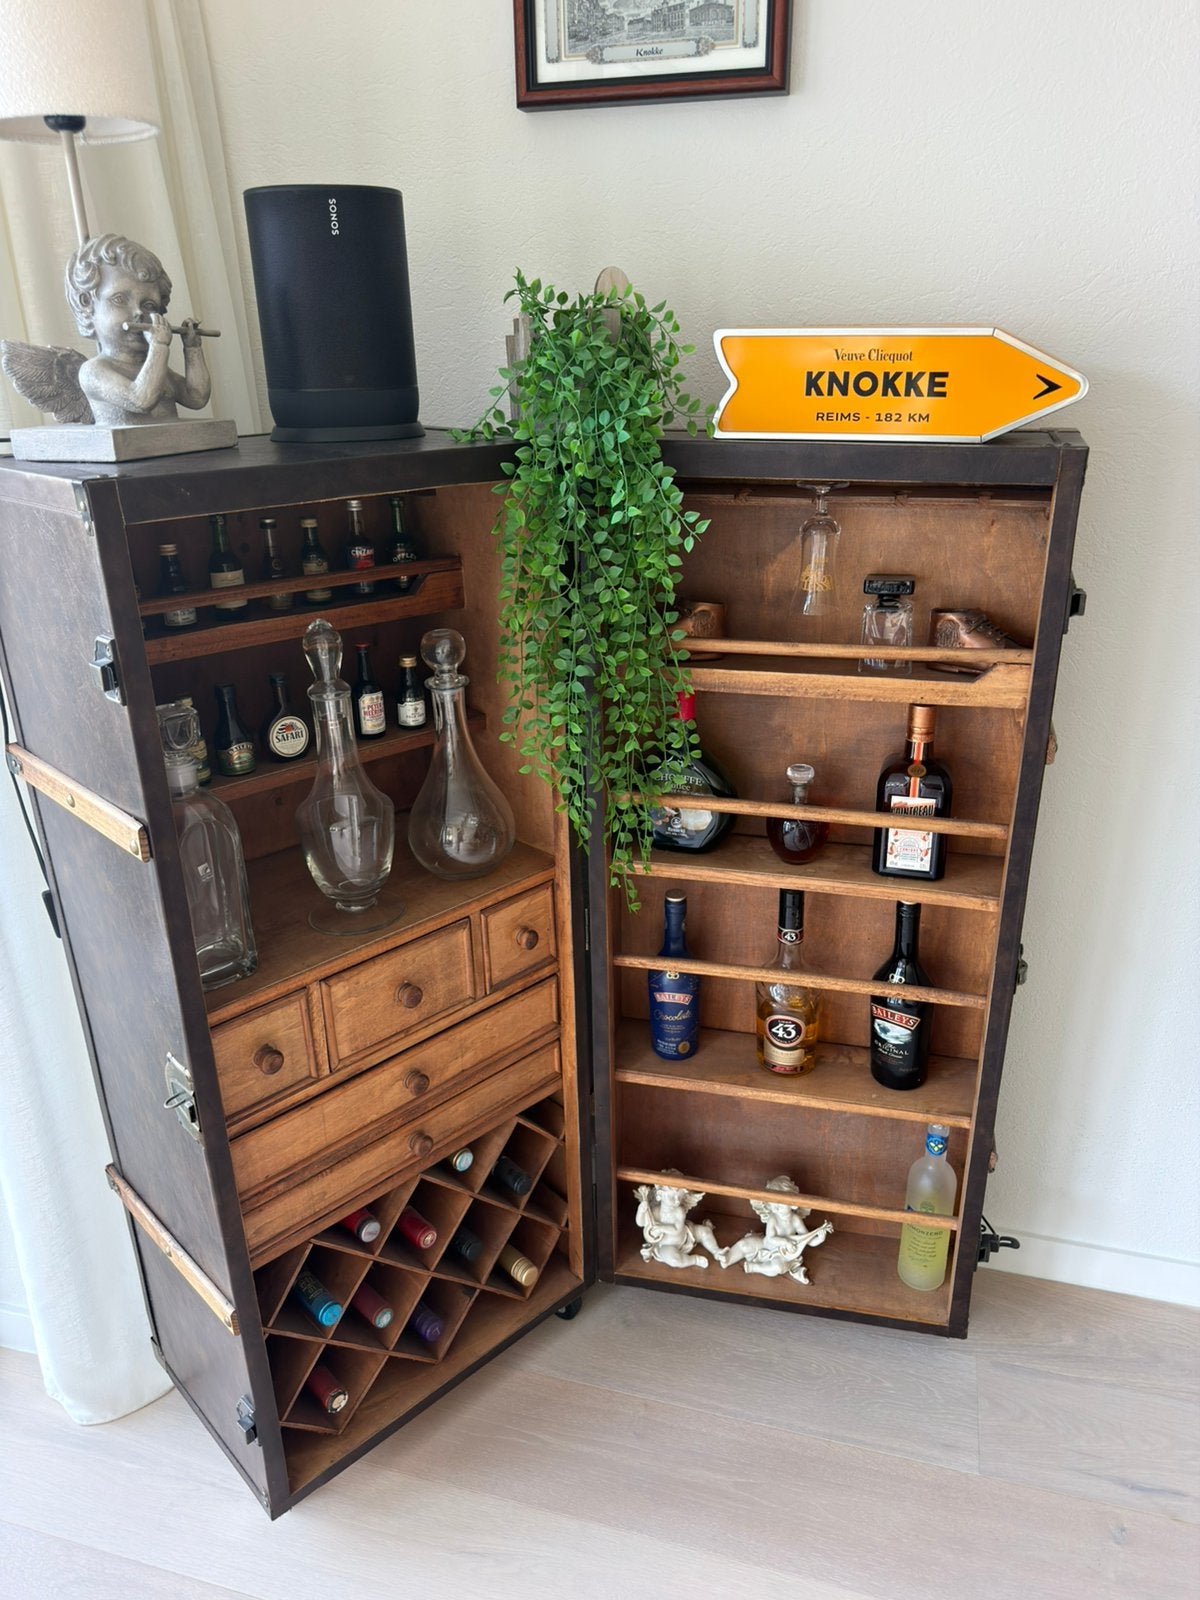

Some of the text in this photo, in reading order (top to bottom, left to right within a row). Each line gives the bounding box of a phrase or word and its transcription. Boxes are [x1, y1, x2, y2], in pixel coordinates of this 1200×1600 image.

[635, 47, 663, 57] Knokke
[328, 198, 340, 236] SONOS
[834, 348, 913, 364] Veuve Clicquot
[804, 370, 950, 398] KNOKKE
[815, 412, 861, 422] REIMS
[875, 412, 902, 423] 182
[908, 413, 930, 423] KM
[275, 730, 304, 743] SAFARI
[655, 773, 704, 787] HOFFE
[784, 931, 796, 941] 43
[872, 1005, 916, 1026] BAILEYS
[771, 1023, 797, 1039] 43
[874, 1039, 909, 1056] ORIGINAL
